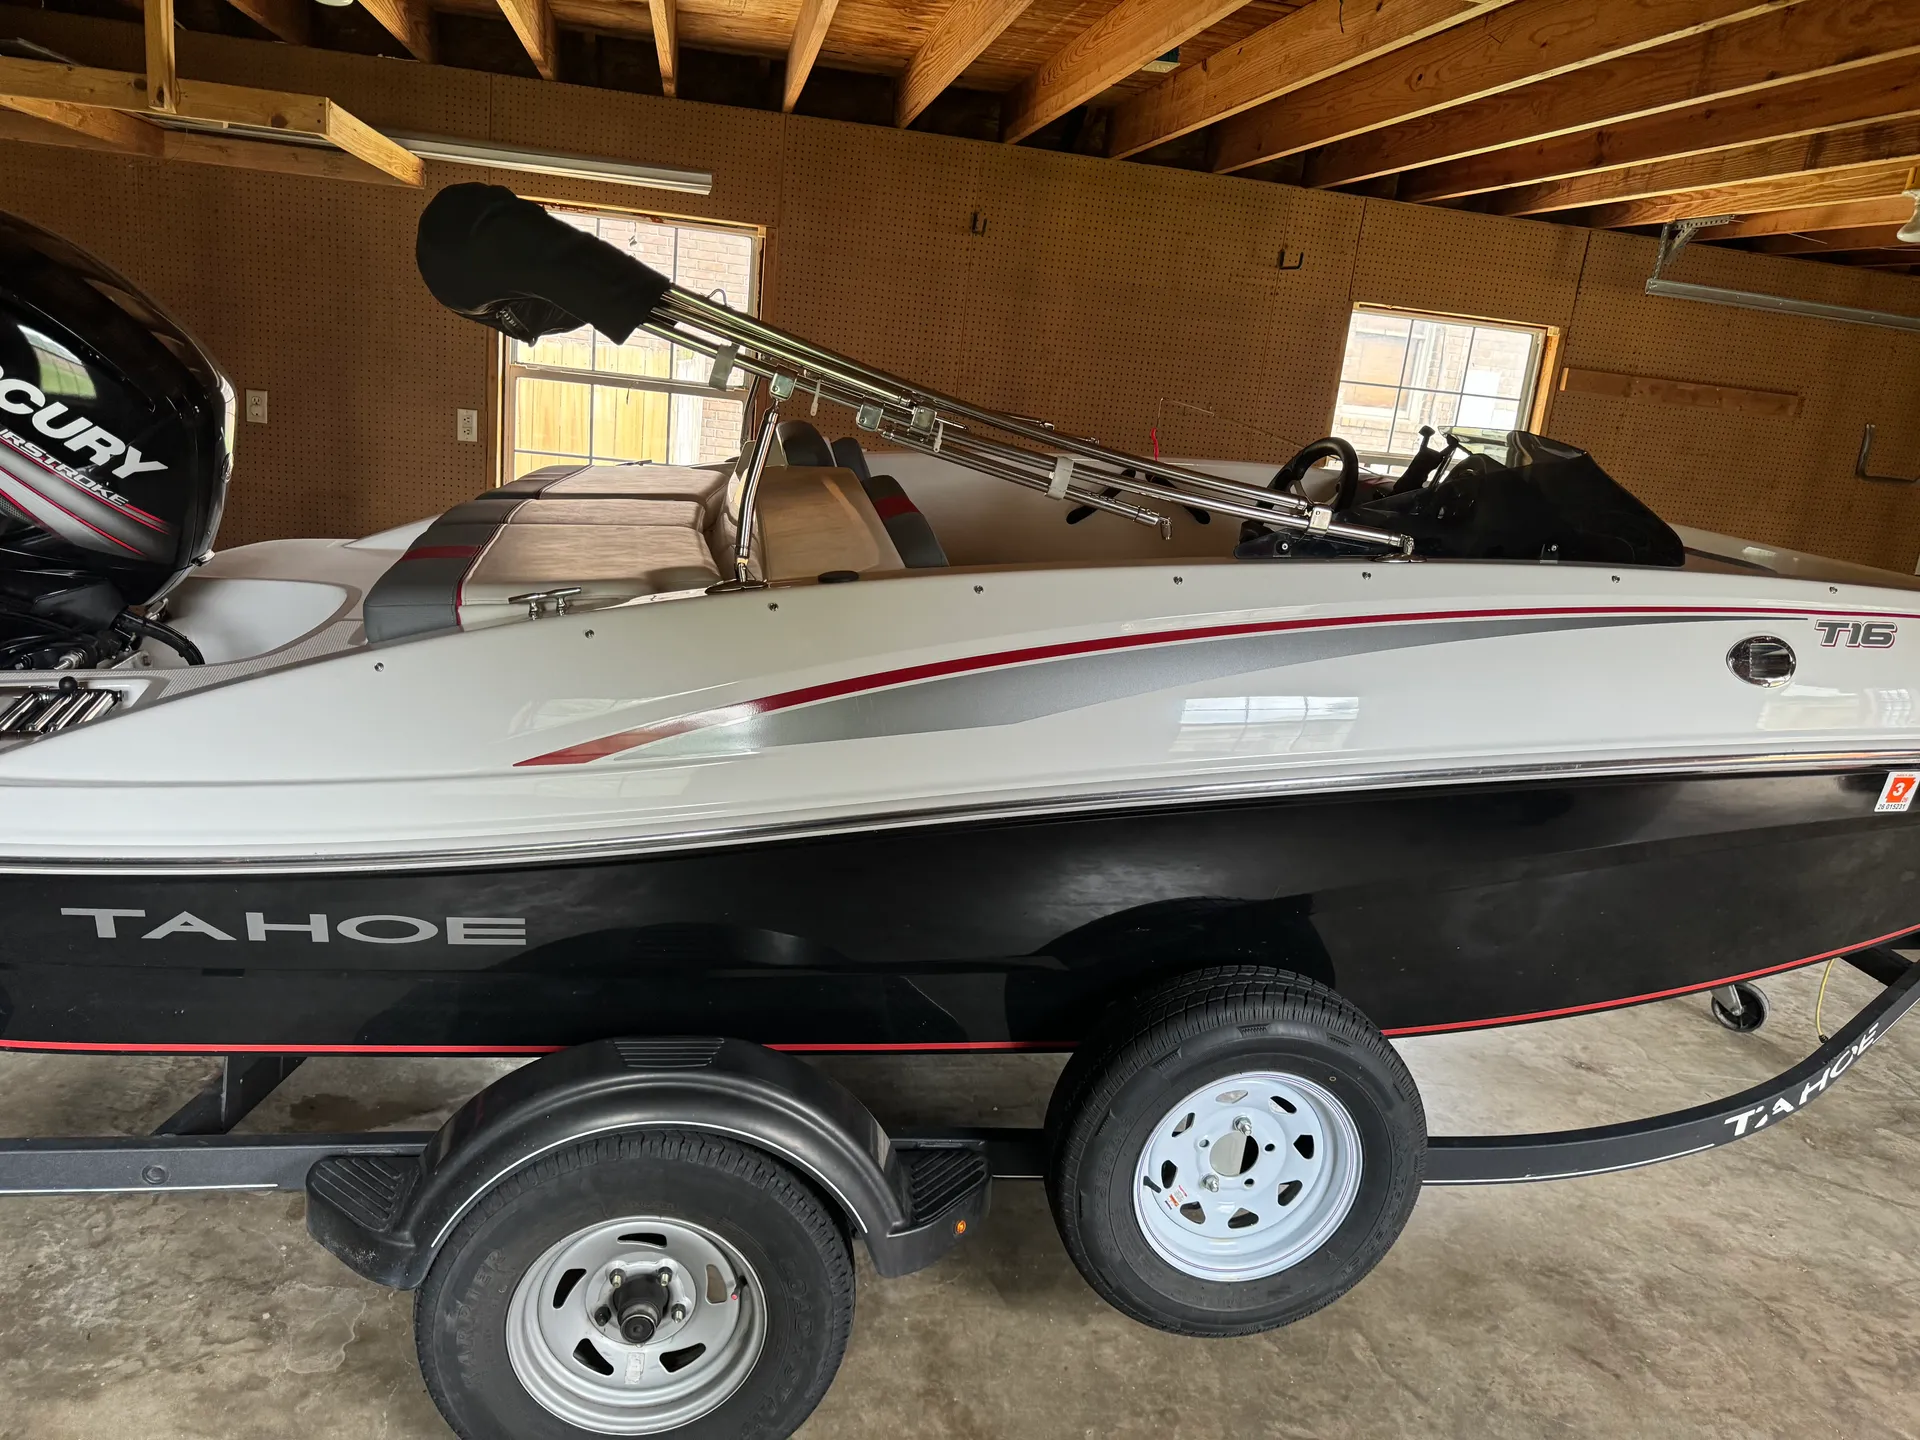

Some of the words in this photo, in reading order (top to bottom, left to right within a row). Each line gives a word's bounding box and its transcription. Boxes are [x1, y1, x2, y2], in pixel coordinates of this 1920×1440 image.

[0, 366, 169, 479] CURY
[1814, 619, 1898, 648] T16
[1893, 782, 1905, 796] 3
[61, 907, 527, 946] TAHOE
[1724, 1022, 1879, 1136] TAHOE
